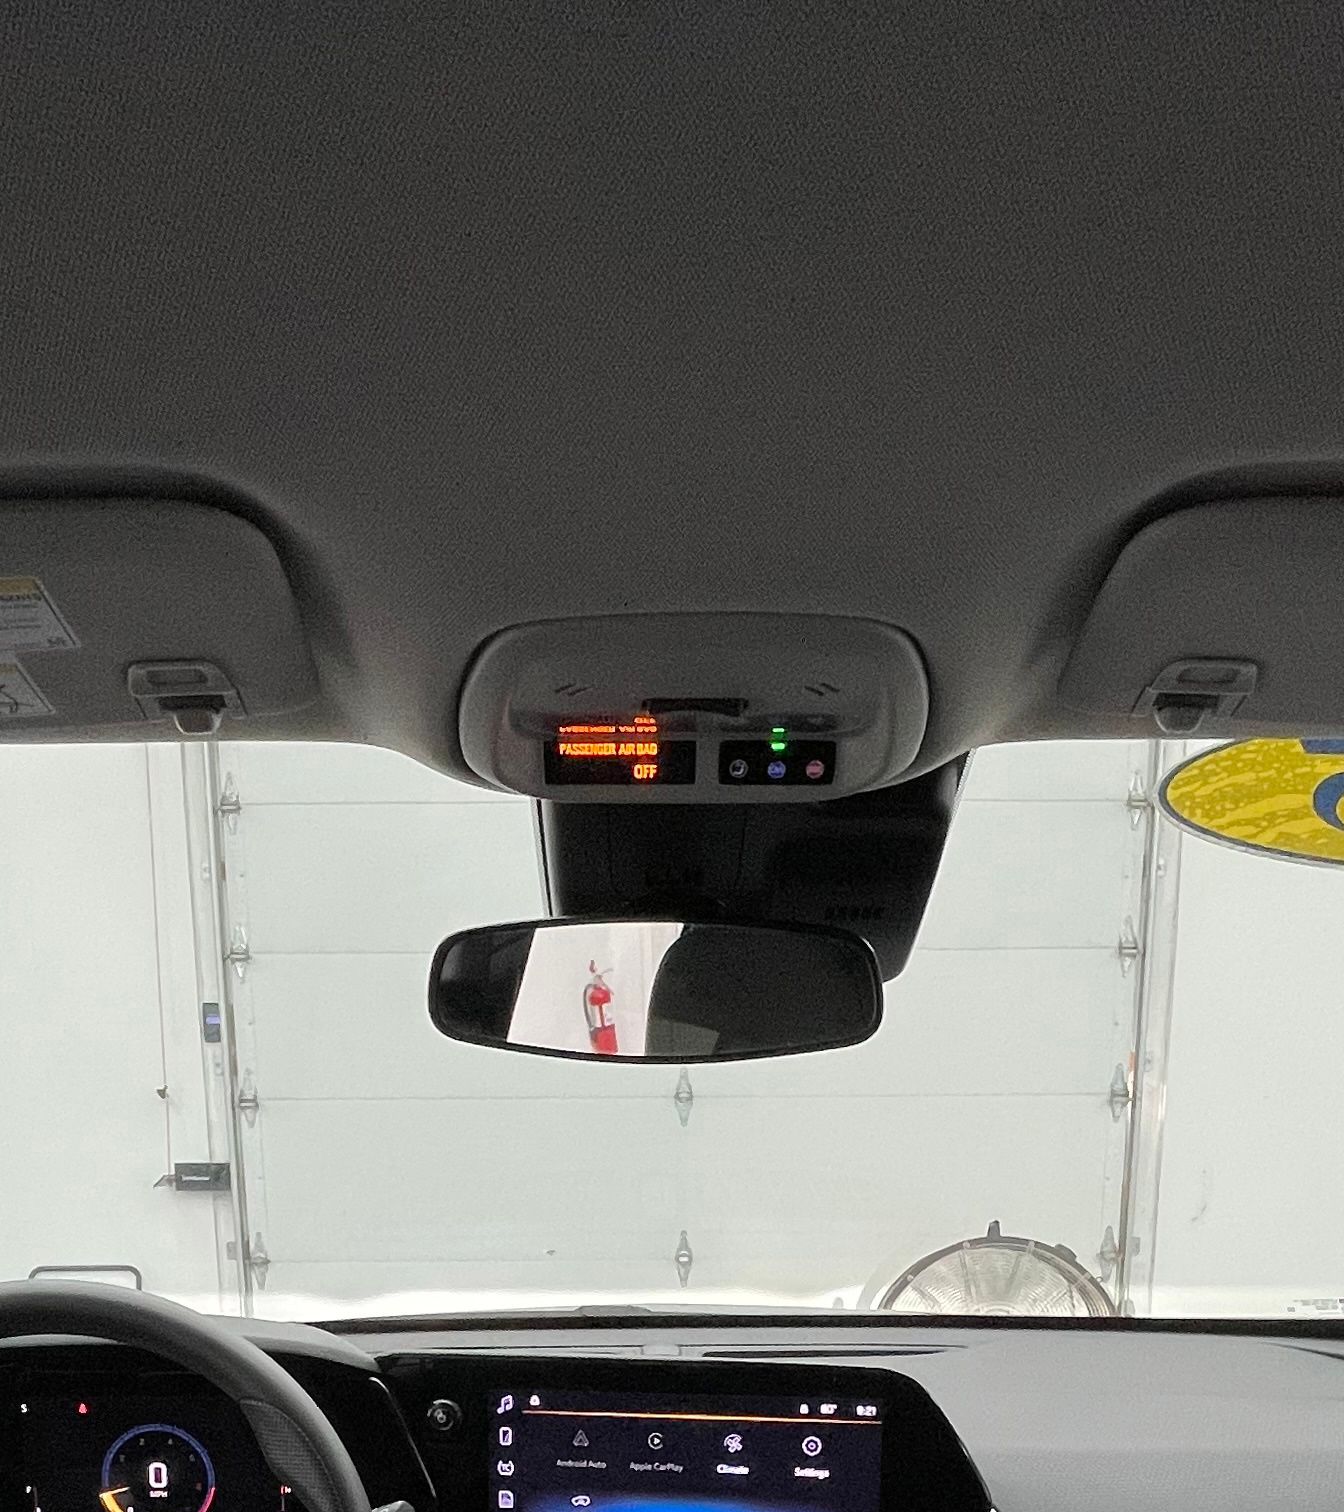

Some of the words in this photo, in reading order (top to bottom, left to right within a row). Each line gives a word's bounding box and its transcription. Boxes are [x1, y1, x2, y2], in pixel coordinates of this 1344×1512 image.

[559, 743, 616, 755] PASSENGER
[618, 743, 636, 755] AIR
[634, 764, 657, 779] OFF
[588, 1460, 607, 1469] Auto
[630, 1461, 652, 1471] Apple
[653, 1462, 683, 1473] CarPlay
[148, 1461, 168, 1489] 0
